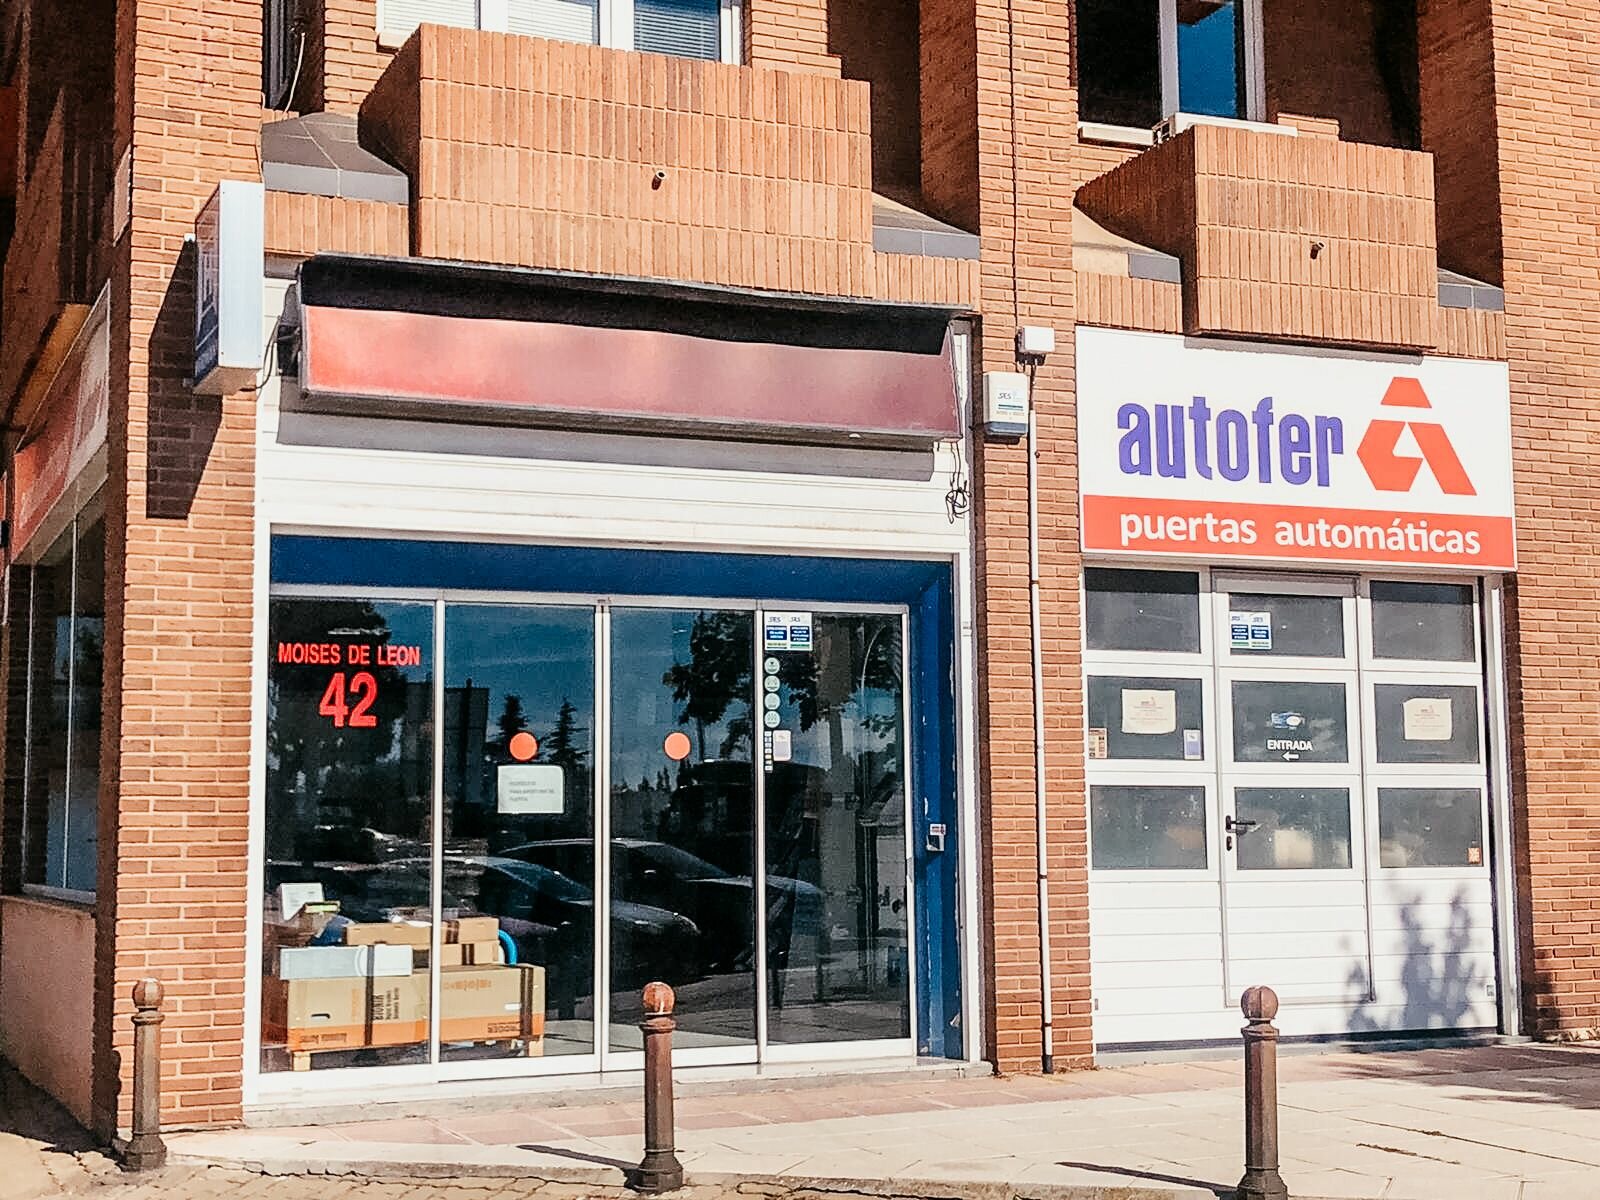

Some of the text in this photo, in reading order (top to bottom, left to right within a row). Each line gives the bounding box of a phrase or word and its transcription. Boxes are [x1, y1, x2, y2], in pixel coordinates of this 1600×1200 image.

[1117, 396, 1344, 487] autofer
[1119, 511, 1482, 555] puertas automáticas
[278, 642, 421, 666] MOISES DE LEON
[318, 671, 378, 728] 42
[1266, 739, 1313, 751] ENTRADA
